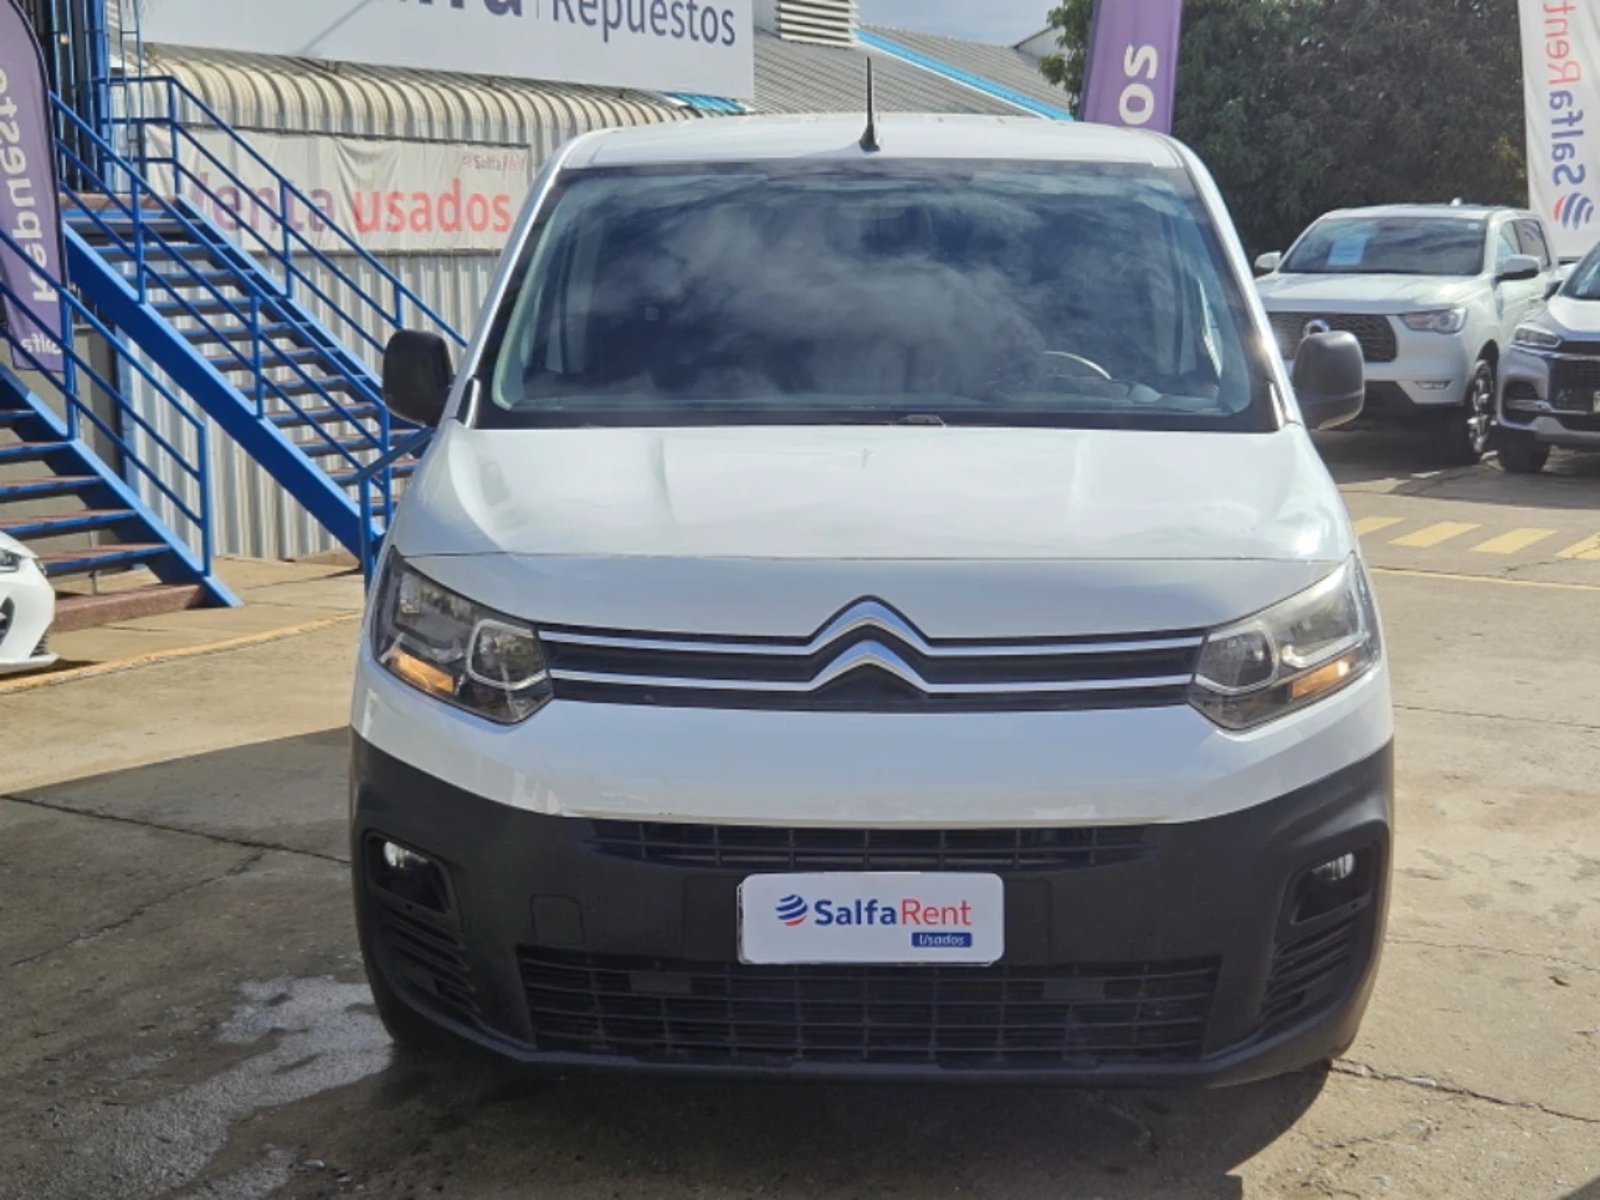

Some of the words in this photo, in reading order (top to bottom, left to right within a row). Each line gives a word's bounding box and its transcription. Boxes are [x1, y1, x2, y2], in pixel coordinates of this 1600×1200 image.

[352, 178, 512, 233] usados
[814, 898, 972, 926] SalfaRent
[919, 932, 965, 946] Usados
